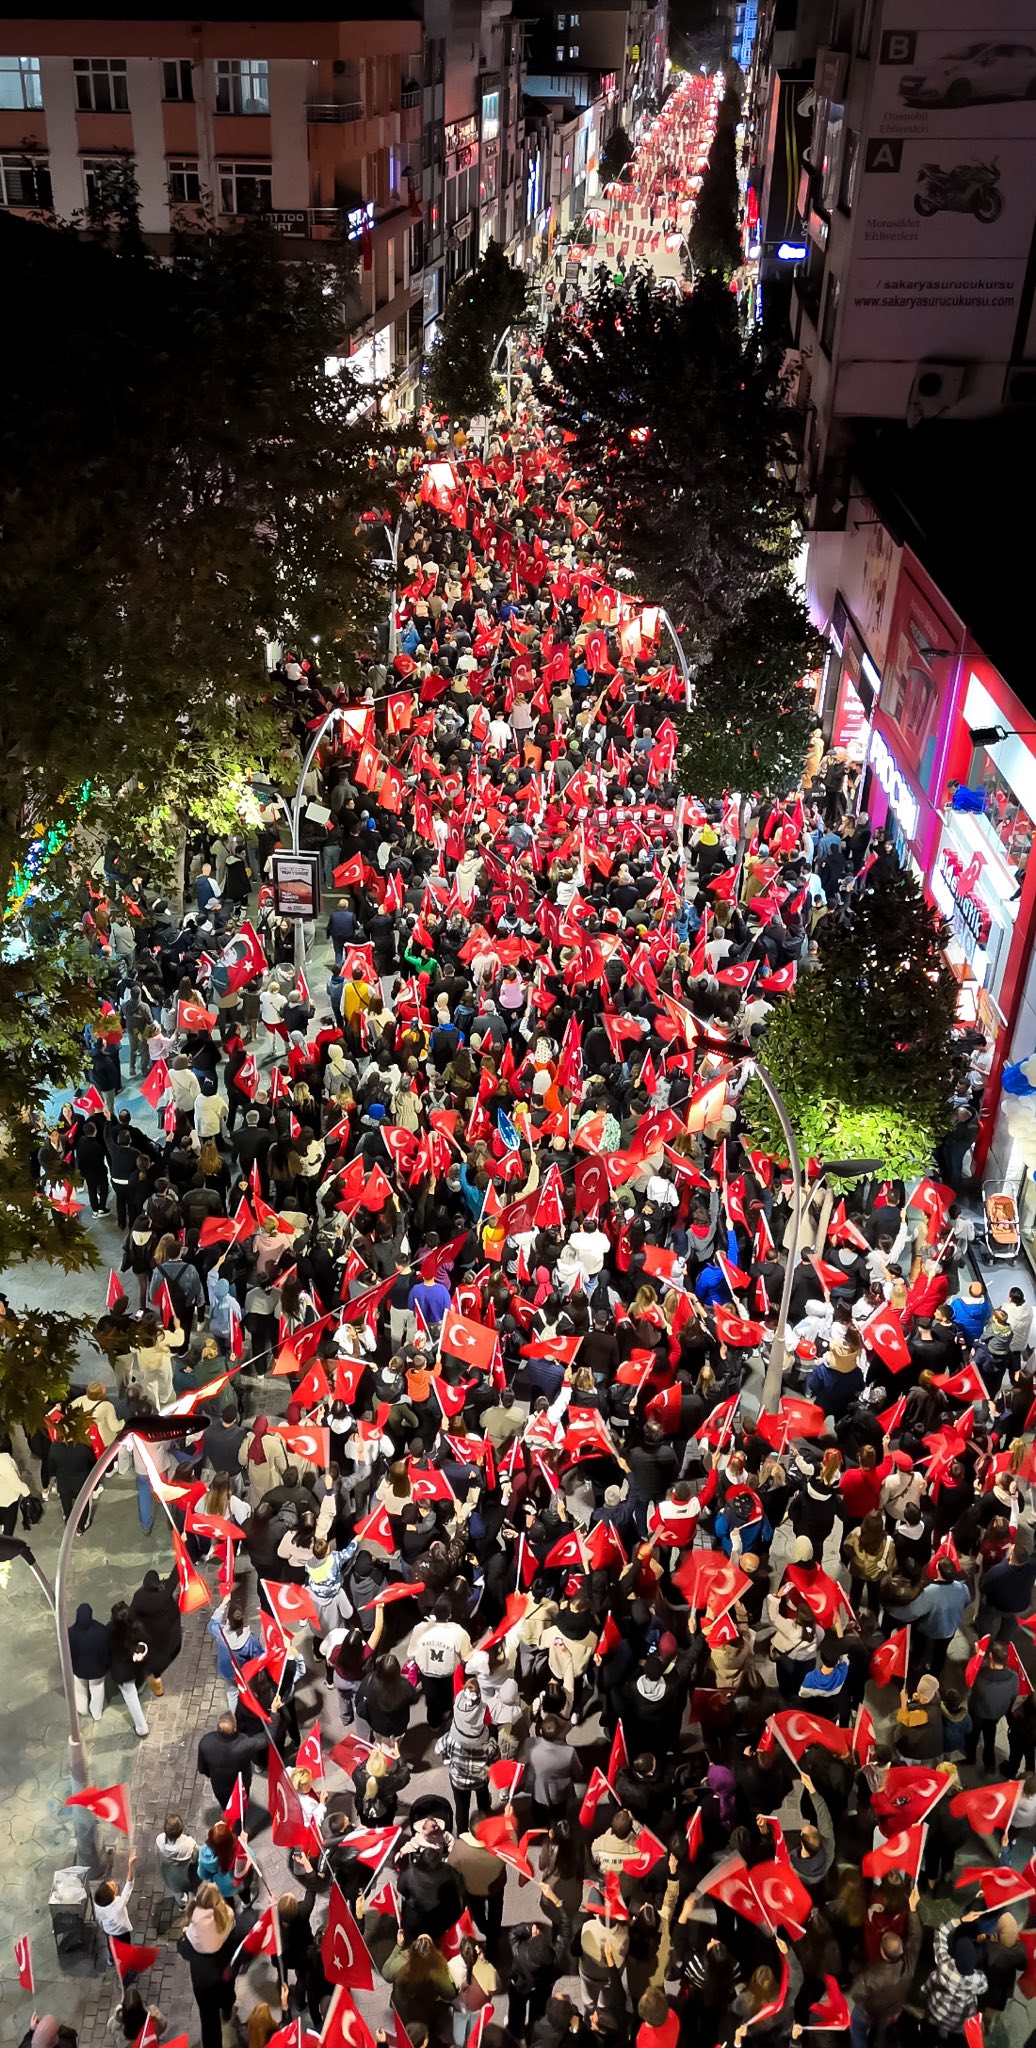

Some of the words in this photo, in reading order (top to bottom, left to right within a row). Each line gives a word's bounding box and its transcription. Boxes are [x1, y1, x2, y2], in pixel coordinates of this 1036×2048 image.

[889, 35, 909, 59] B
[871, 143, 895, 167] A
[884, 279, 1015, 292] sakaryasurucukursu
[854, 295, 1015, 310] www.sakaryasurucukursu.com
[430, 1648, 444, 1662] M
